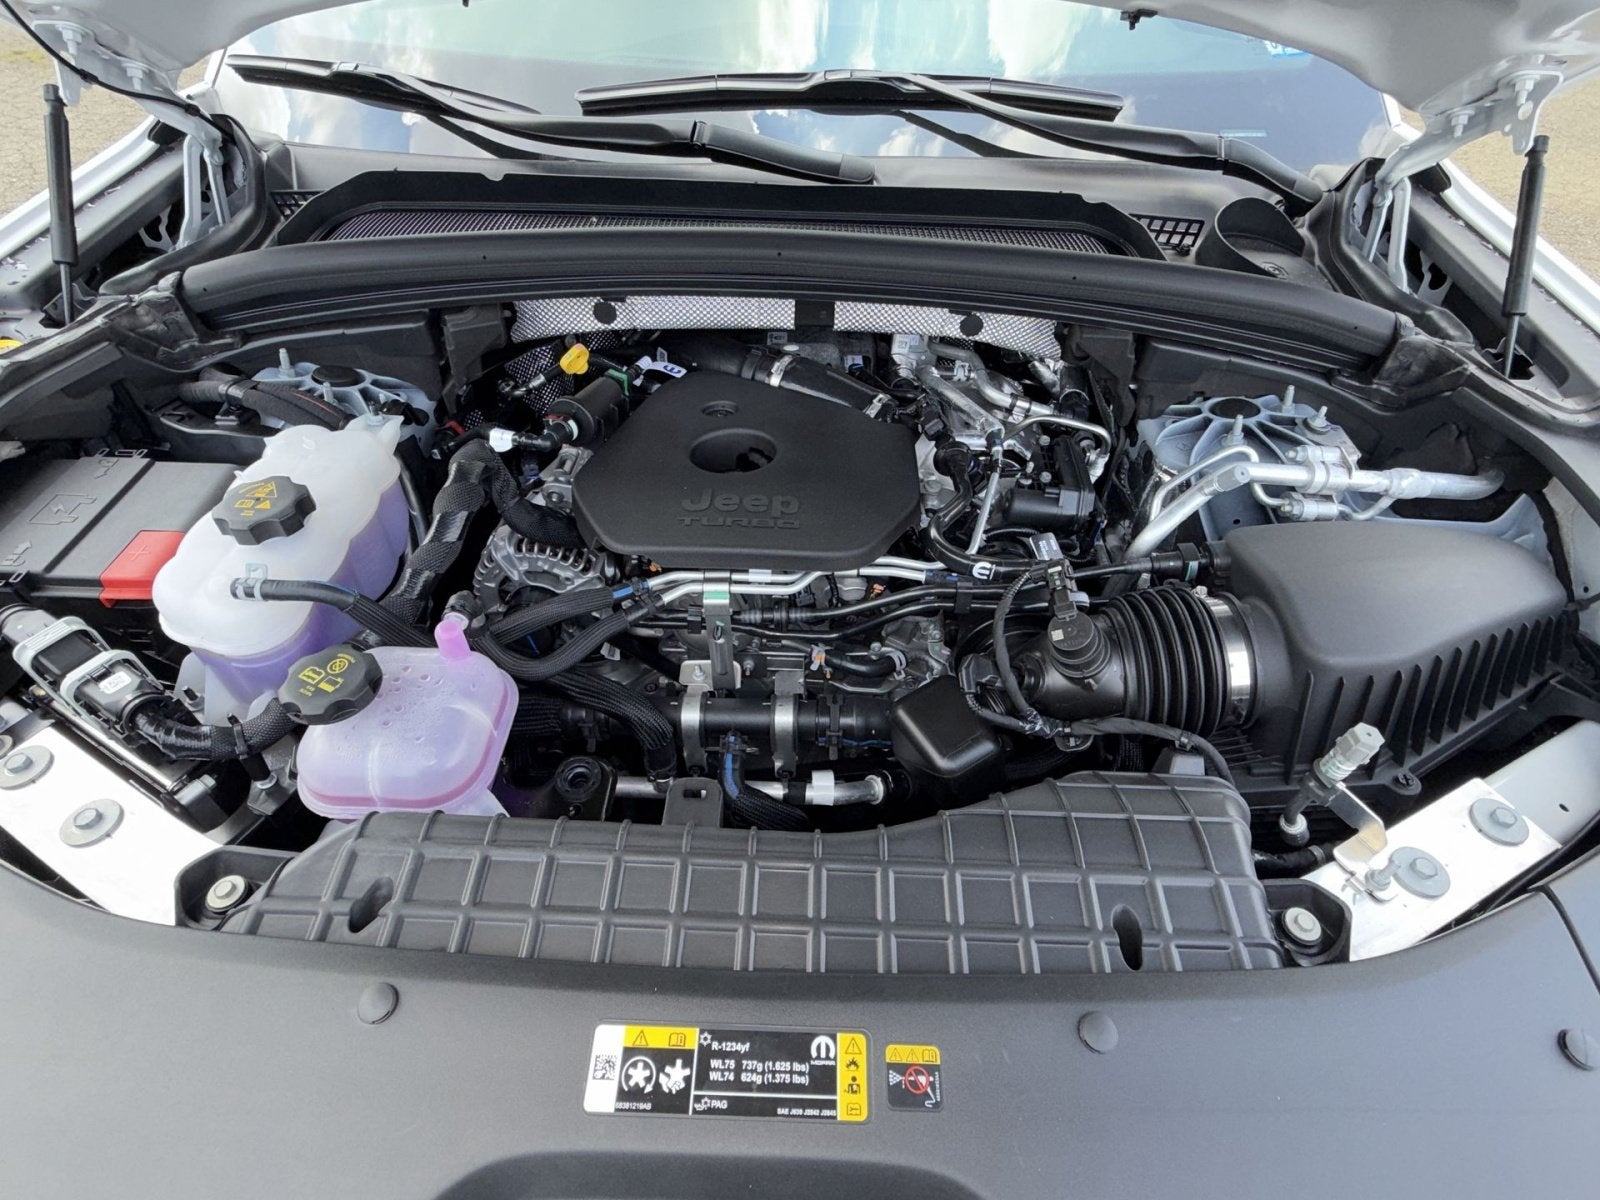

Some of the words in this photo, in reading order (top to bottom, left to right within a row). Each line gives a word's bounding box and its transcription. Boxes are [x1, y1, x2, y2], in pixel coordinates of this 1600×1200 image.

[681, 488, 800, 518] Jeep
[677, 516, 801, 530] TURBO
[711, 1041, 751, 1053] R-1234yf
[710, 1059, 735, 1069] WL75
[741, 1060, 763, 1072] 737g
[765, 1061, 791, 1073] (1.625
[792, 1062, 809, 1074] lbs)
[709, 1071, 734, 1081] WL74
[741, 1072, 763, 1084] 624g
[764, 1073, 791, 1085] (1.375
[792, 1074, 809, 1086] lbs)
[711, 1100, 728, 1109] PAG
